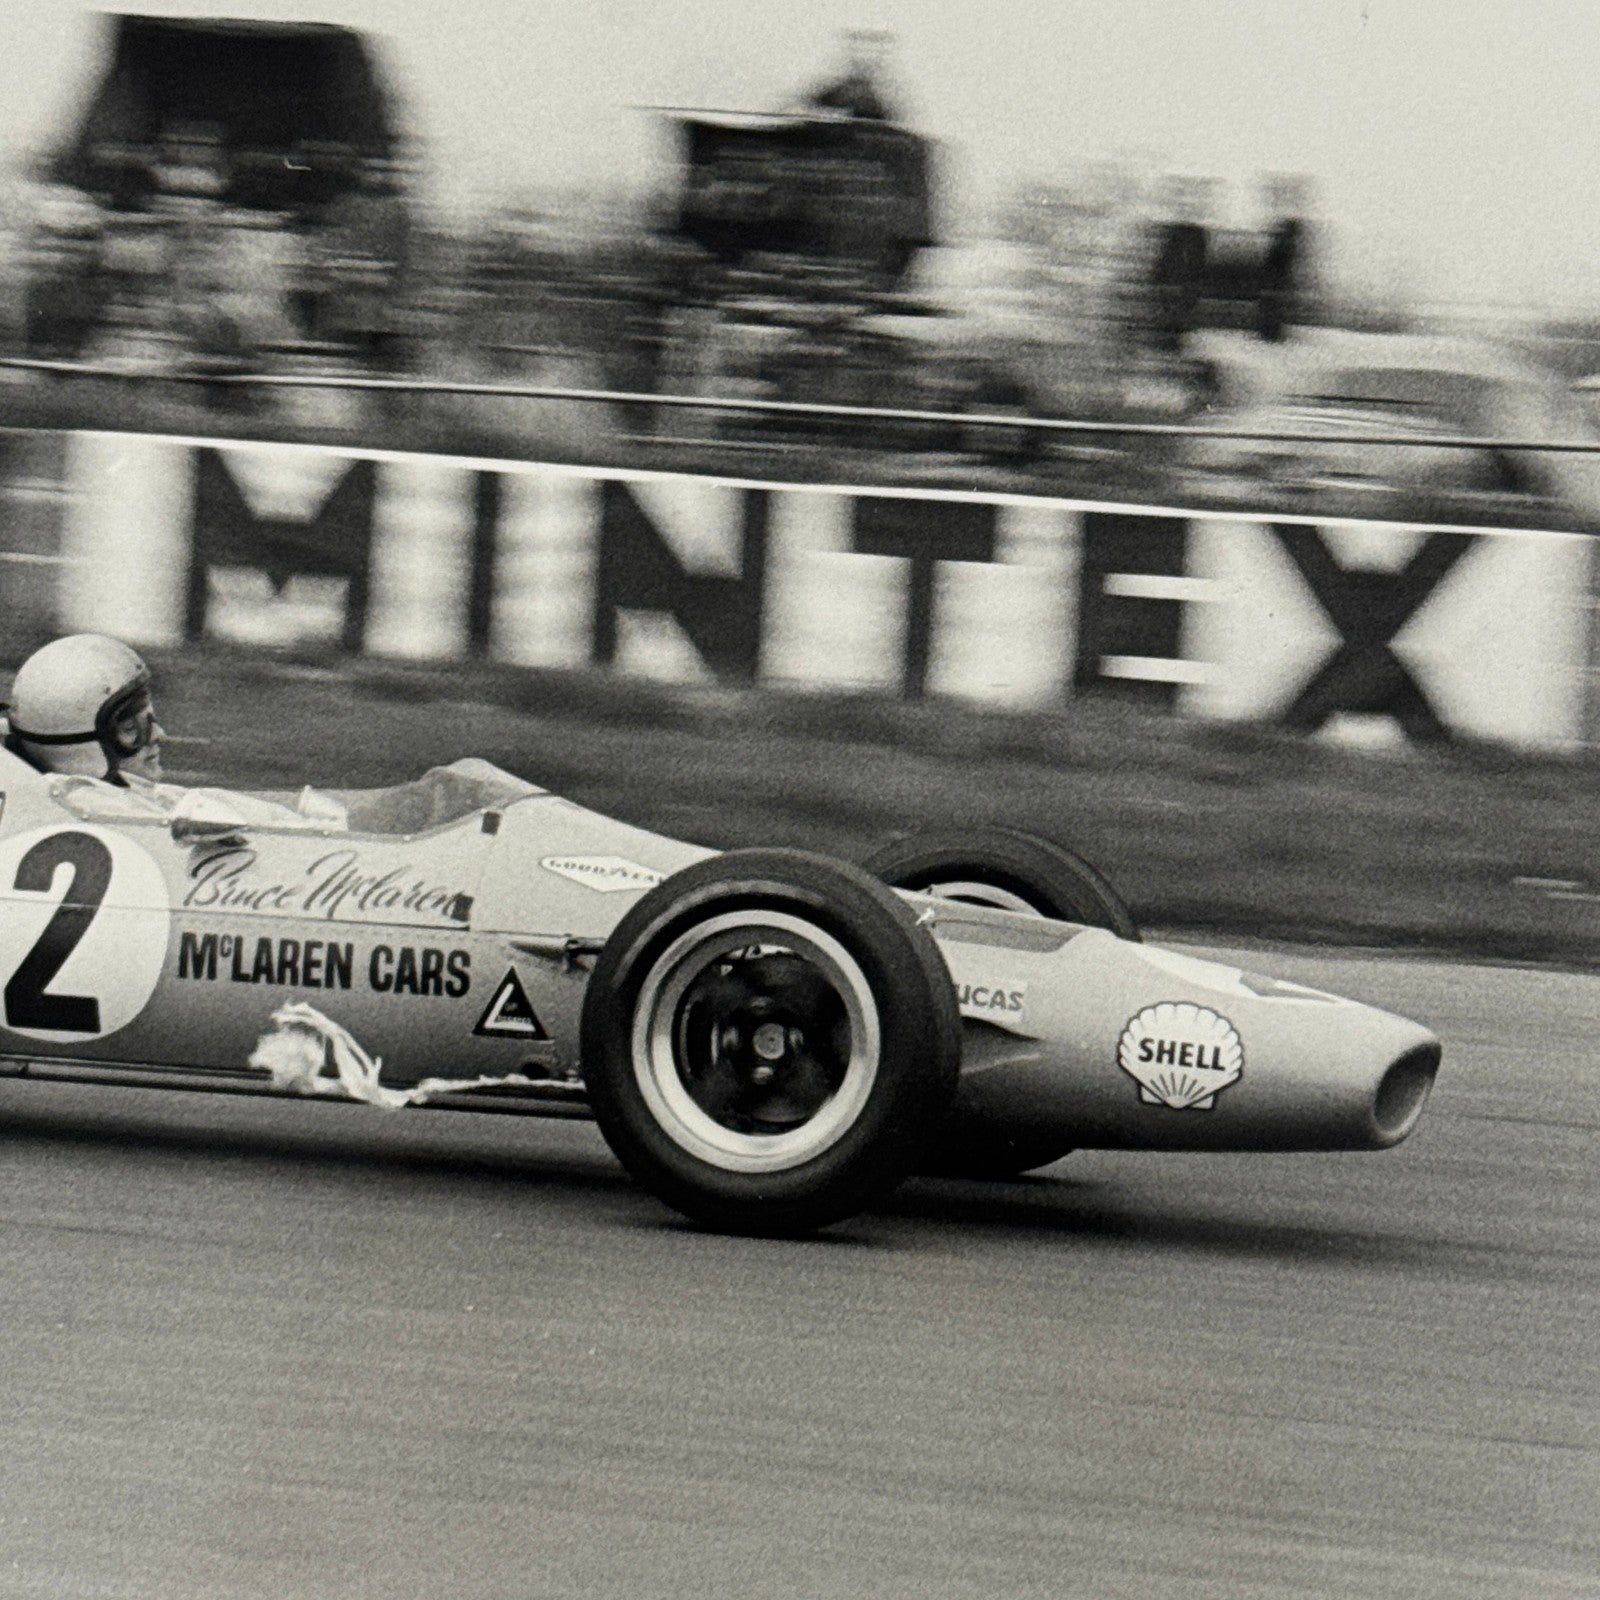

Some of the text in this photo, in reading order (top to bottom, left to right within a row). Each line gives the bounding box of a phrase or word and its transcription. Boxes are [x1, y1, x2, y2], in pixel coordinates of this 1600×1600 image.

[186, 446, 1482, 750] MINTEX
[183, 849, 302, 909] Bruce
[4, 831, 113, 1033] 2
[369, 945, 471, 997] CARS
[956, 984, 1024, 1011] UCAS
[1138, 1037, 1226, 1072] SHELL
